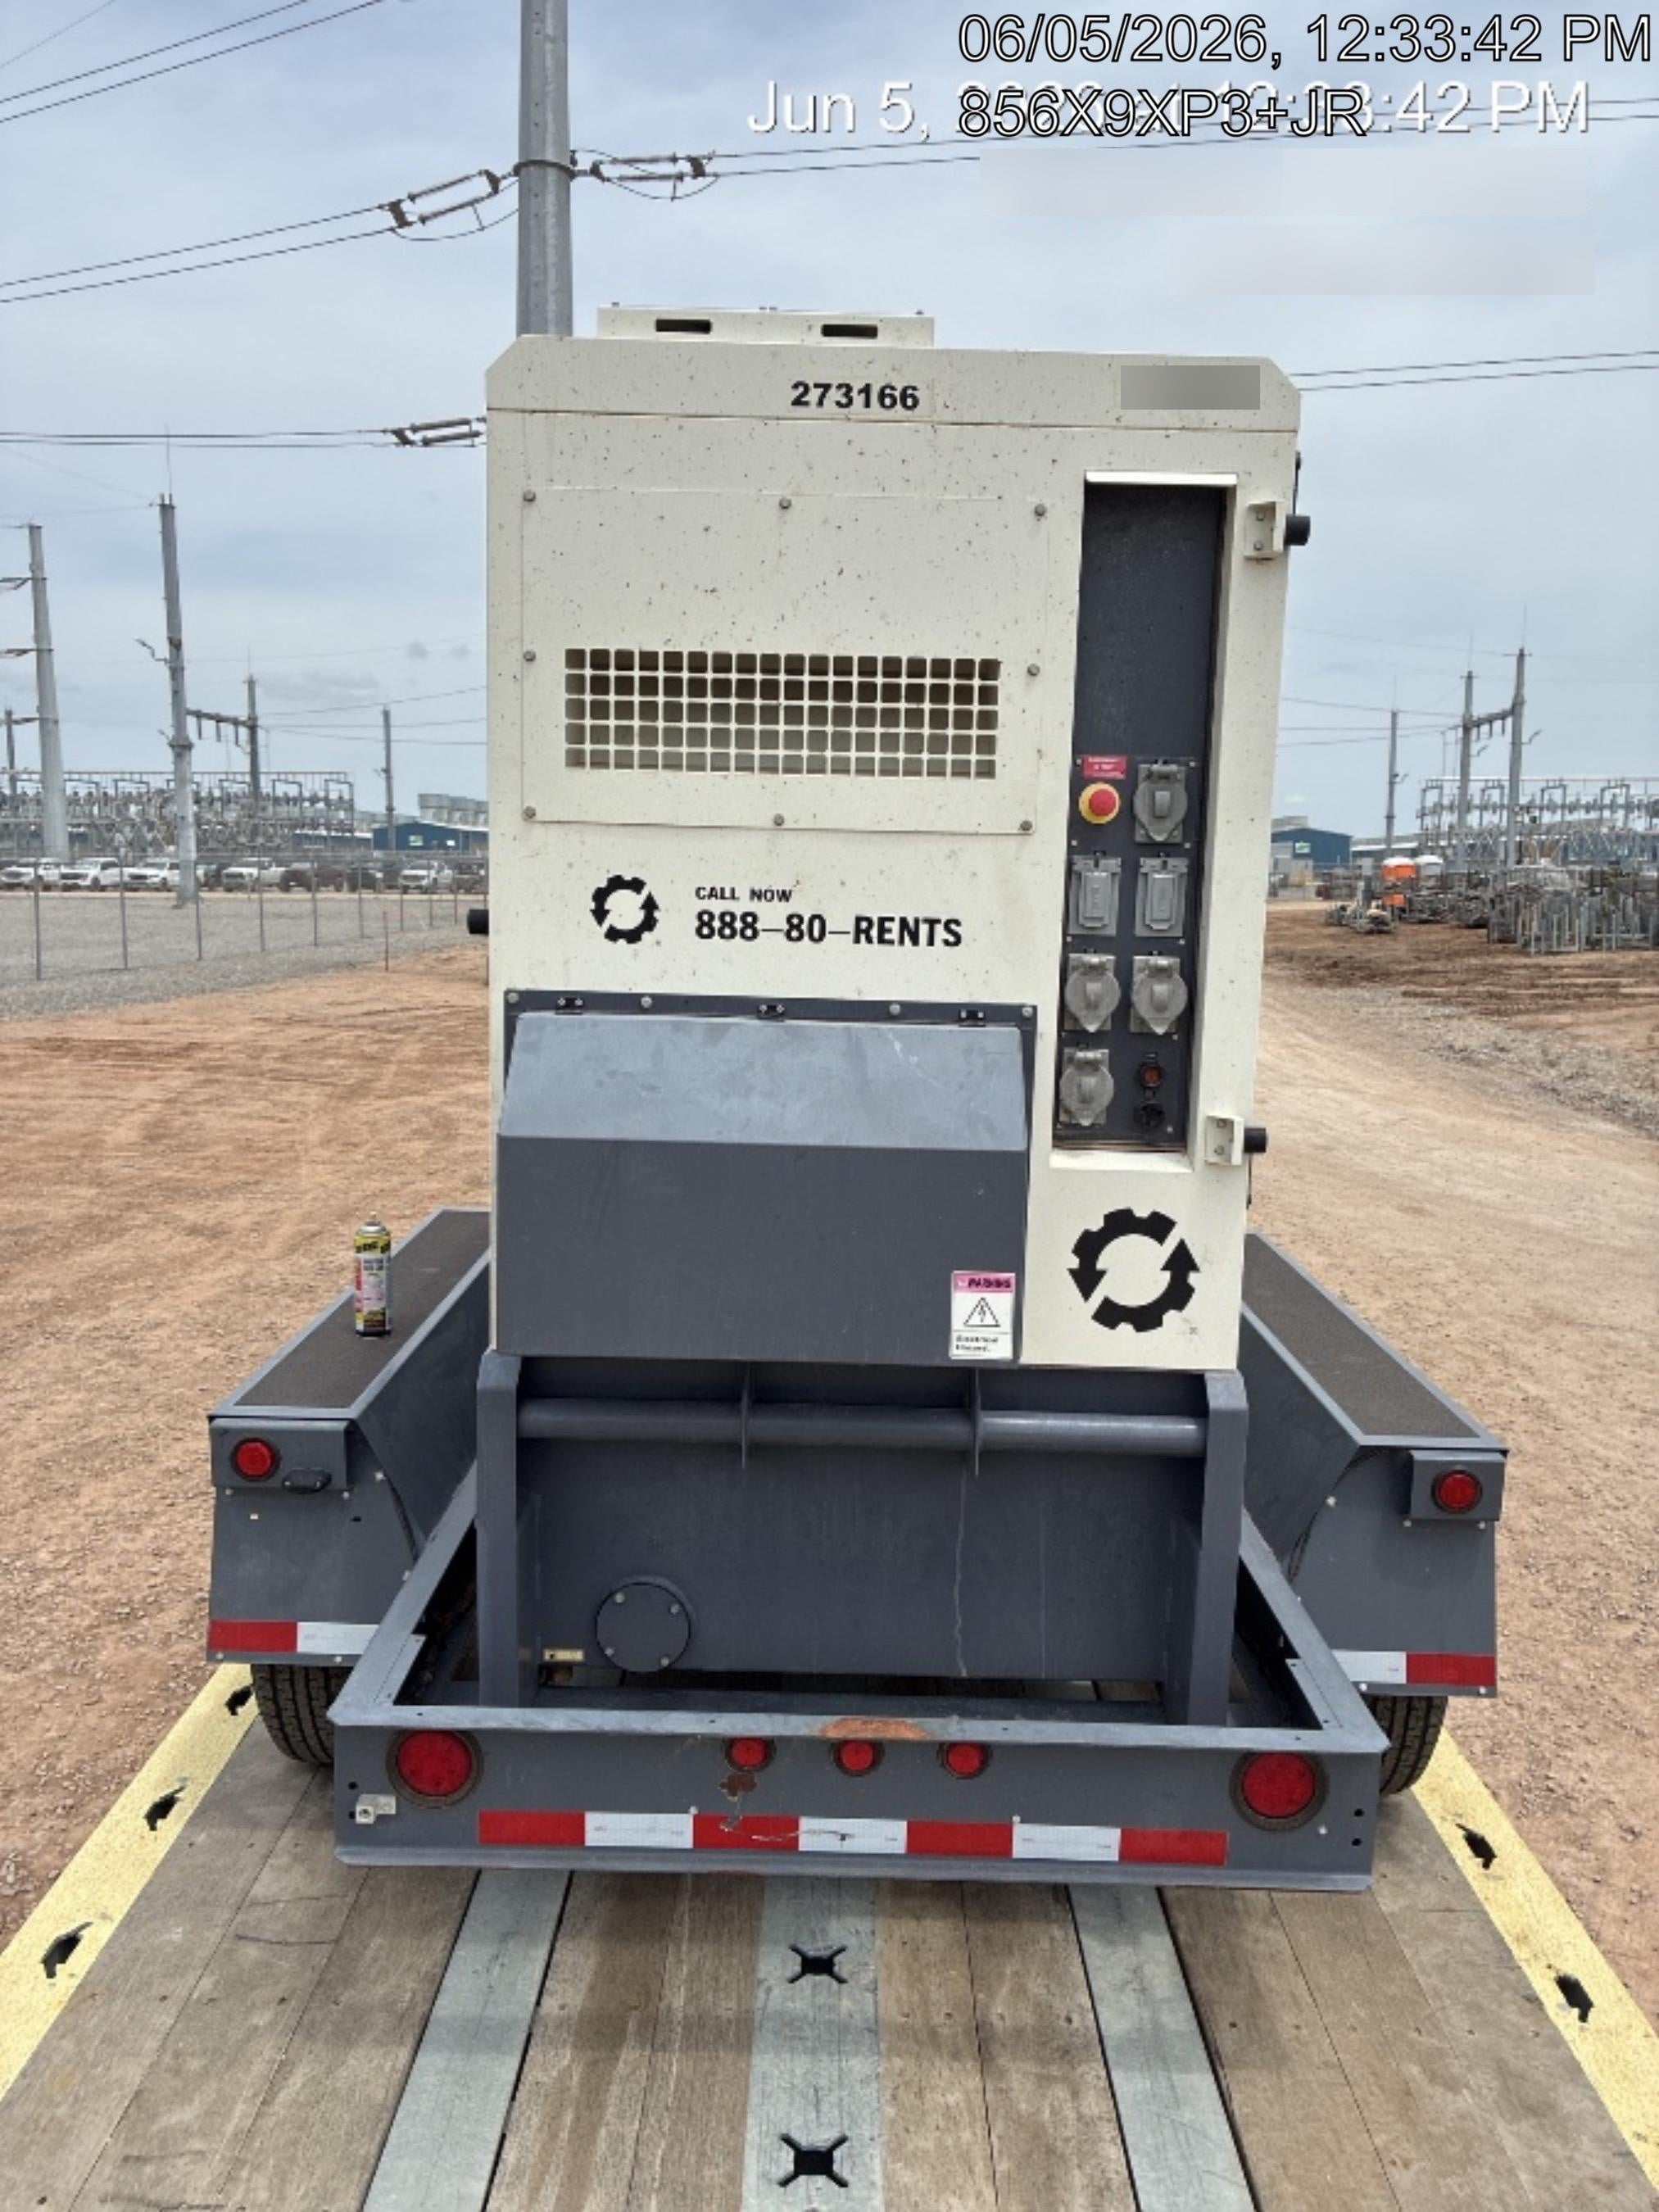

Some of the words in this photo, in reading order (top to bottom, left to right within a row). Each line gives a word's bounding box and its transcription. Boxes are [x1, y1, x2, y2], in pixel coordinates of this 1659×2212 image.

[791, 380, 921, 411] 273166
[695, 886, 740, 902] CALL
[749, 888, 793, 904] NOW
